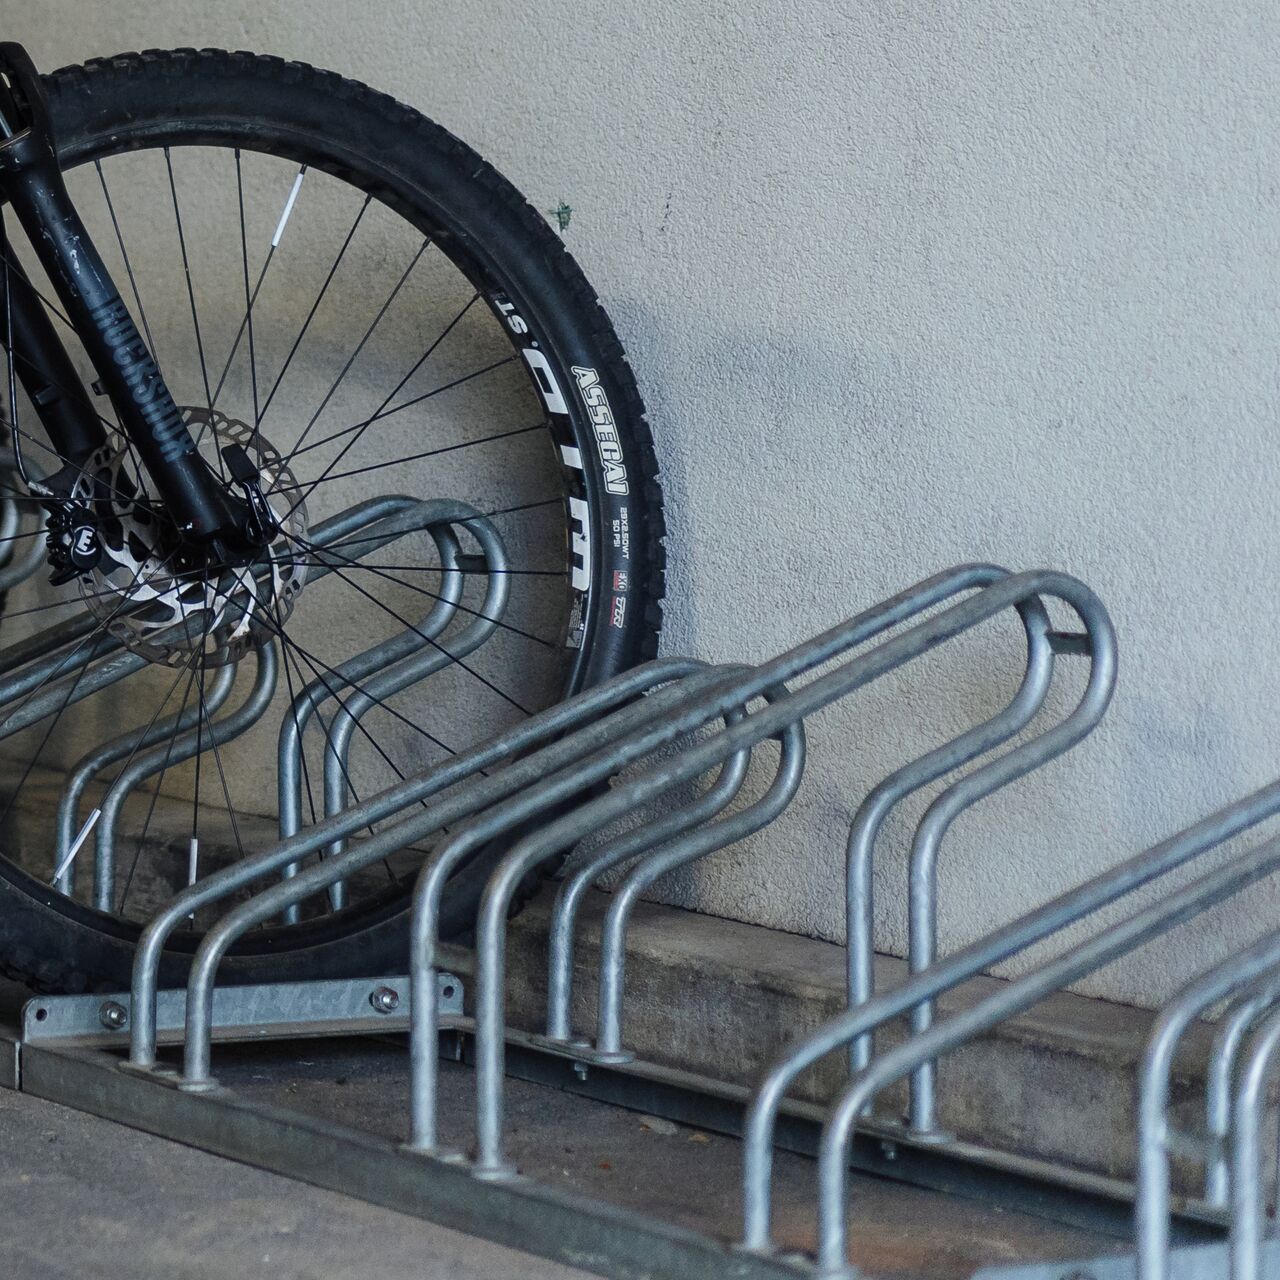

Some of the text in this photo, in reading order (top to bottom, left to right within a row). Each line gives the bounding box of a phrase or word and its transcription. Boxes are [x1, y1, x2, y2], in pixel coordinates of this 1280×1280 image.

[571, 365, 630, 496] ASSEGAI
[612, 519, 621, 533] 50
[620, 505, 631, 560] 29X2.50WT
